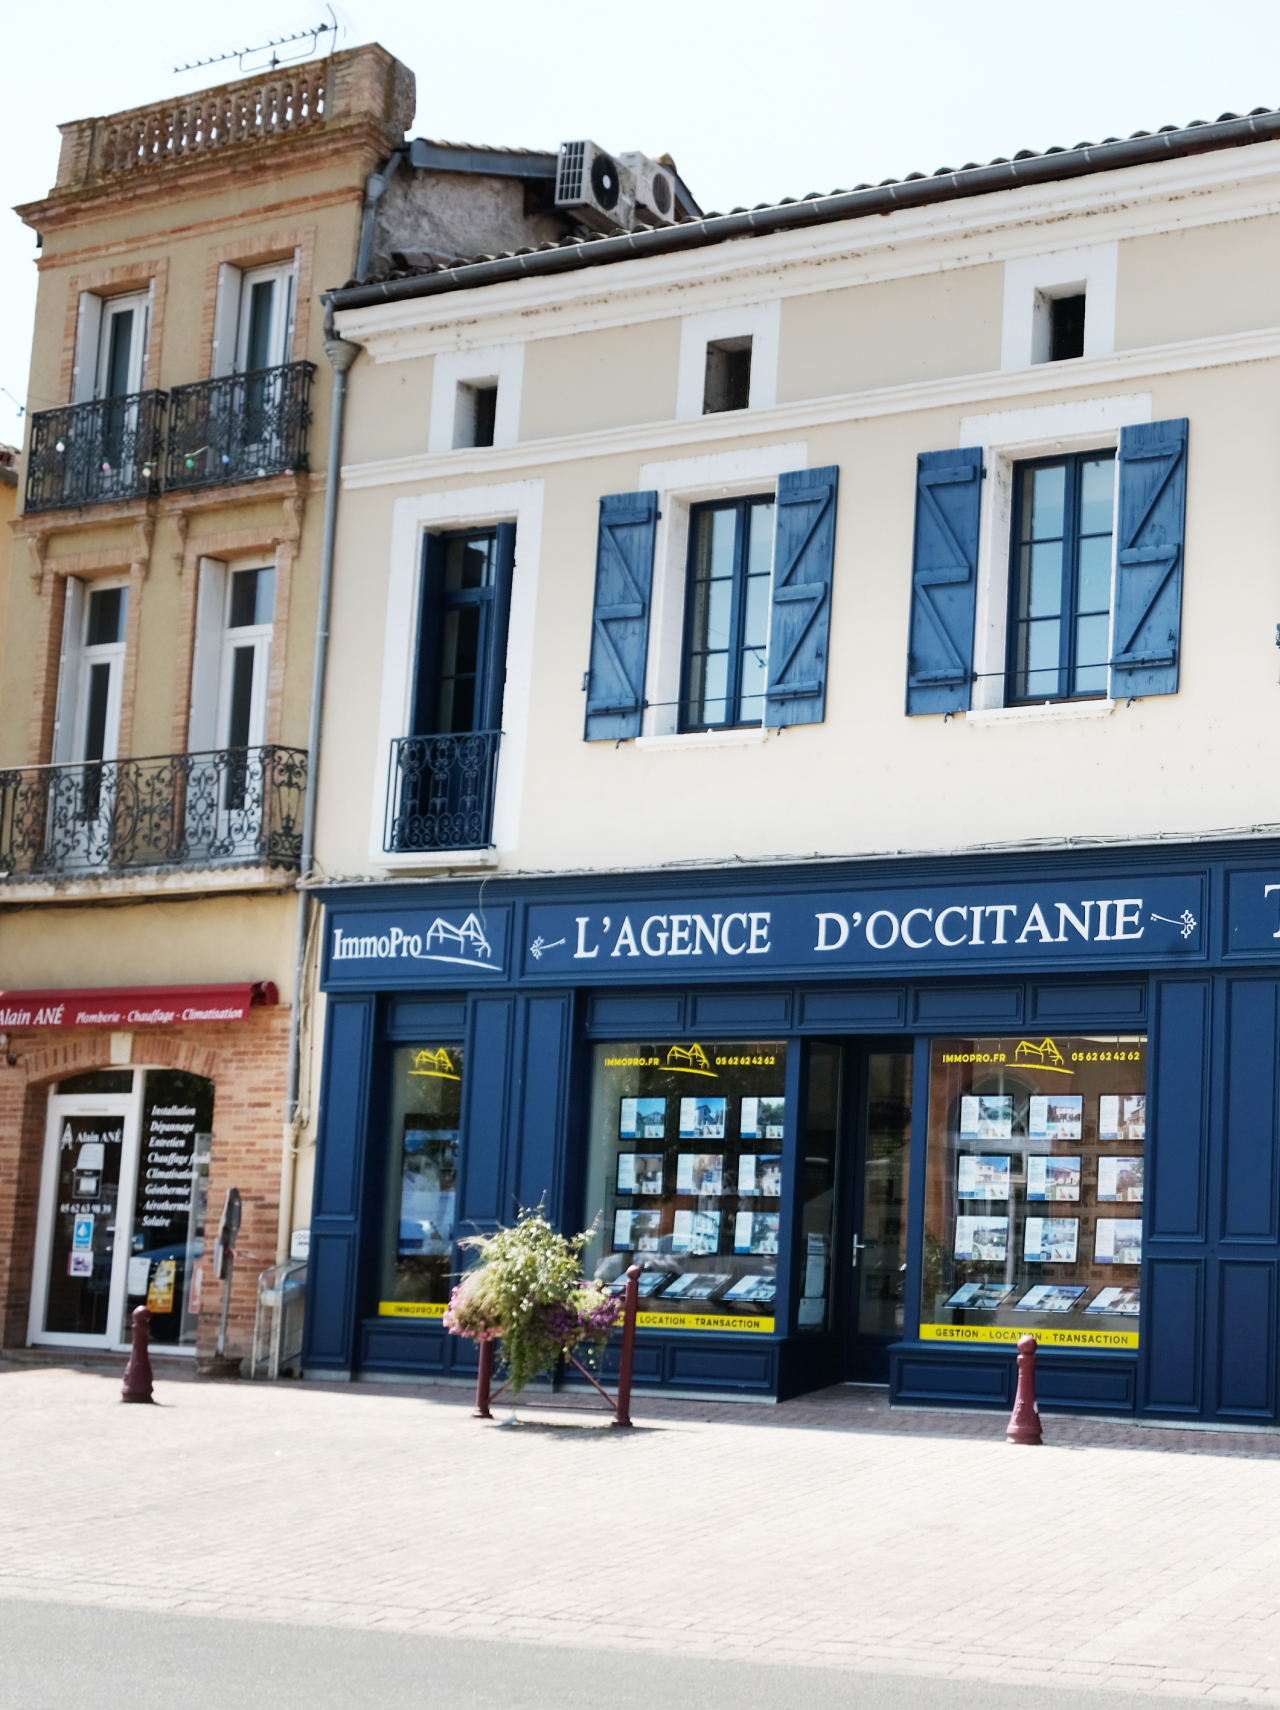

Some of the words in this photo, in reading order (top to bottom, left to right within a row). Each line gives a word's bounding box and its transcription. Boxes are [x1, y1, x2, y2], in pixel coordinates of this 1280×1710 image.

[332, 927, 422, 960] ImmoPro
[0, 1008, 30, 1026] Alain
[33, 1003, 64, 1025] ANÉ
[76, 1011, 121, 1024] Plomberie
[127, 1009, 175, 1023] Chauffage
[182, 1007, 243, 1021] Climatisation
[604, 1057, 660, 1066] IMMOPRO.FR
[715, 1056, 727, 1066] 05
[728, 1056, 738, 1065] 62
[739, 1056, 750, 1065] 62
[751, 1056, 763, 1065] 42
[763, 1056, 775, 1065] 62
[942, 1053, 1006, 1063] IMMOPRO.FR
[1071, 1052, 1084, 1061] 05
[1085, 1052, 1098, 1061] 62
[1099, 1052, 1112, 1061] 62
[1113, 1052, 1126, 1061] 42
[1127, 1051, 1140, 1060] 62
[151, 1105, 196, 1116] Installation
[150, 1120, 195, 1134] Dépannage
[76, 1130, 99, 1143] Alain
[100, 1128, 122, 1143] ANÉ
[148, 1136, 186, 1148] Entretien
[147, 1152, 189, 1166] Chauffage
[146, 1167, 199, 1180] Climatisation
[145, 1183, 191, 1196] Géothermie
[60, 1203, 70, 1214] 05
[70, 1203, 80, 1213] 62
[142, 1200, 192, 1212] Aérothermie
[141, 1215, 171, 1227] Solaire
[394, 1305, 445, 1315] IMMOPRO.FR
[639, 1316, 686, 1326] LOCATION
[695, 1318, 760, 1329] TRANSACTION
[935, 1328, 979, 1339] GESTION
[989, 1331, 1042, 1341] LOCATON
[1053, 1333, 1128, 1344] TRANSACTION
